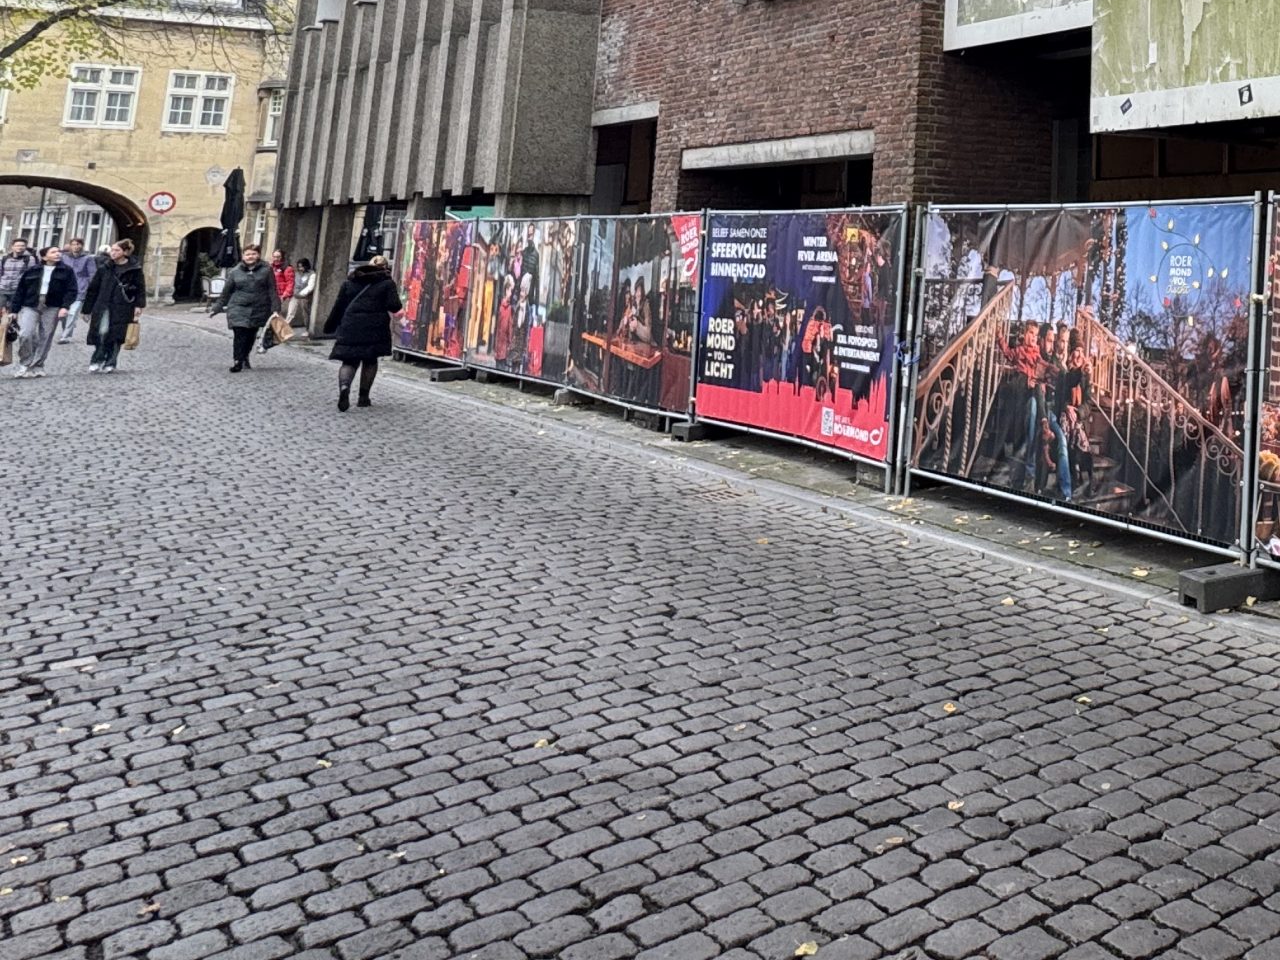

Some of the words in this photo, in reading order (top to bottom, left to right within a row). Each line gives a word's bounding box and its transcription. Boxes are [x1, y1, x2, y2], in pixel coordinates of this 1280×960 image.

[680, 226, 698, 245] ROER
[751, 227, 767, 238] ONZE
[803, 236, 827, 247] WINTER
[711, 242, 767, 259] SFEERVOLLE
[797, 250, 815, 261] FEVER
[816, 251, 839, 262] ARENA
[1170, 255, 1193, 267] ROER
[710, 262, 766, 279] BINNENSTAD
[1169, 267, 1193, 277] MOND
[708, 316, 735, 335] ROER
[706, 332, 736, 351] MOND
[704, 360, 735, 380] LICHT
